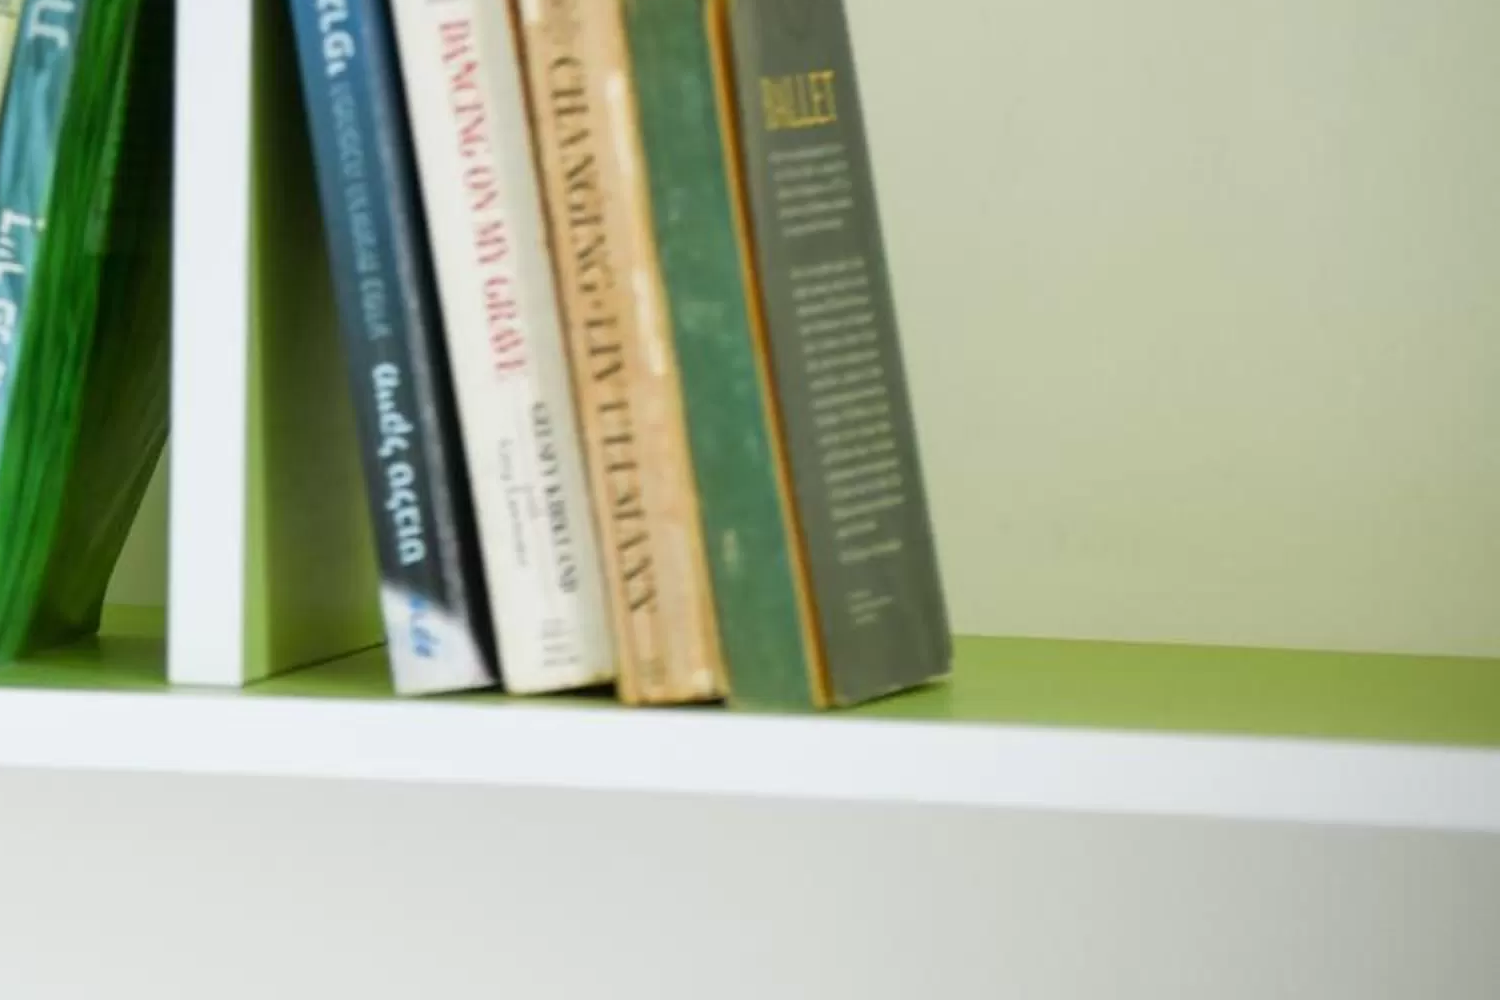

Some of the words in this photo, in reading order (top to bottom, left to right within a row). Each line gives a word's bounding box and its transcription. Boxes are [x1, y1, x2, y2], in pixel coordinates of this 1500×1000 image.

[438, 19, 486, 157] DANCING
[760, 70, 836, 131] BALLET
[465, 164, 500, 212] ON
[474, 220, 510, 266] MY
[371, 362, 414, 458] מייקל
[385, 462, 426, 567] טלבוט
